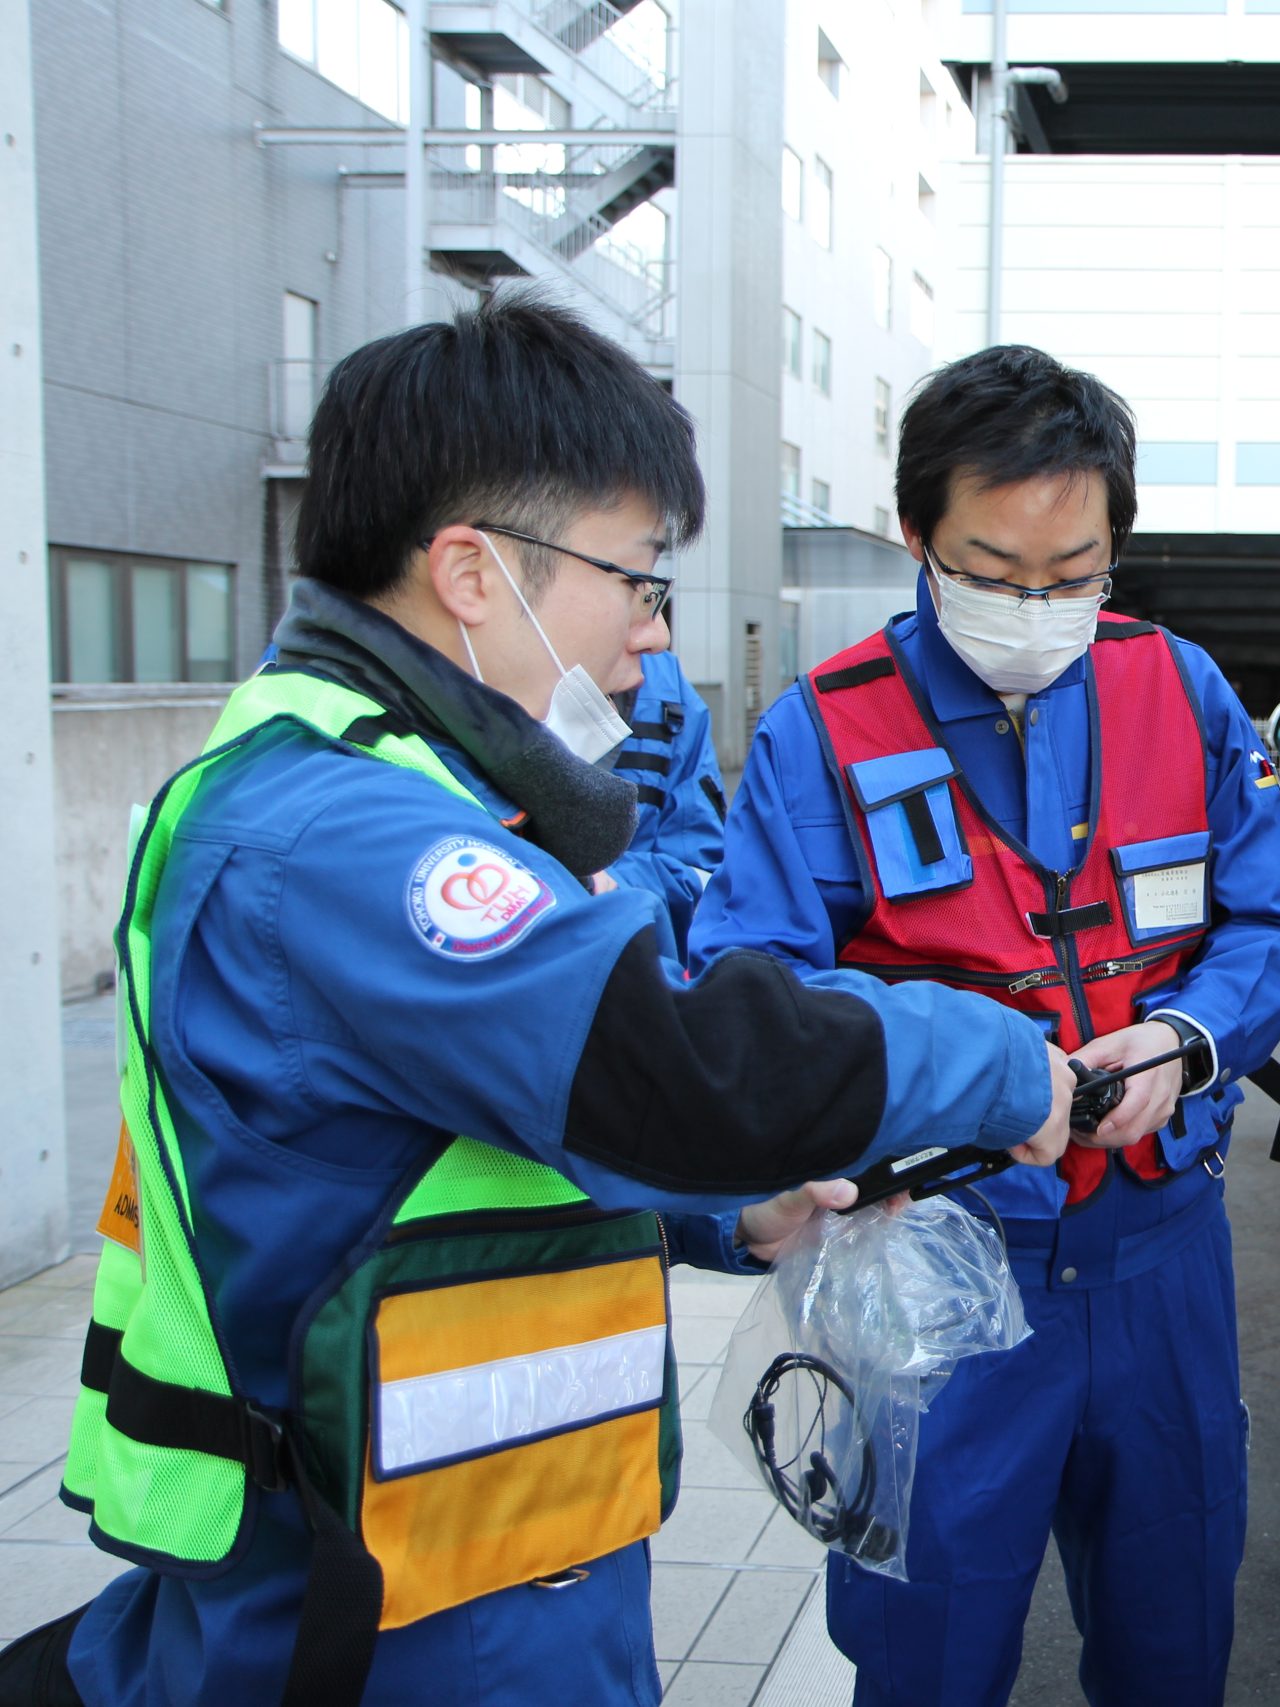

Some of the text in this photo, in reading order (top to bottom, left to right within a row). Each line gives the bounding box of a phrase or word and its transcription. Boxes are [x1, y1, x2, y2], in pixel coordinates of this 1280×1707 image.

[412, 839, 519, 931] TOHOKU UNIVERSITY HOSPITAL
[480, 885, 531, 922] TUH
